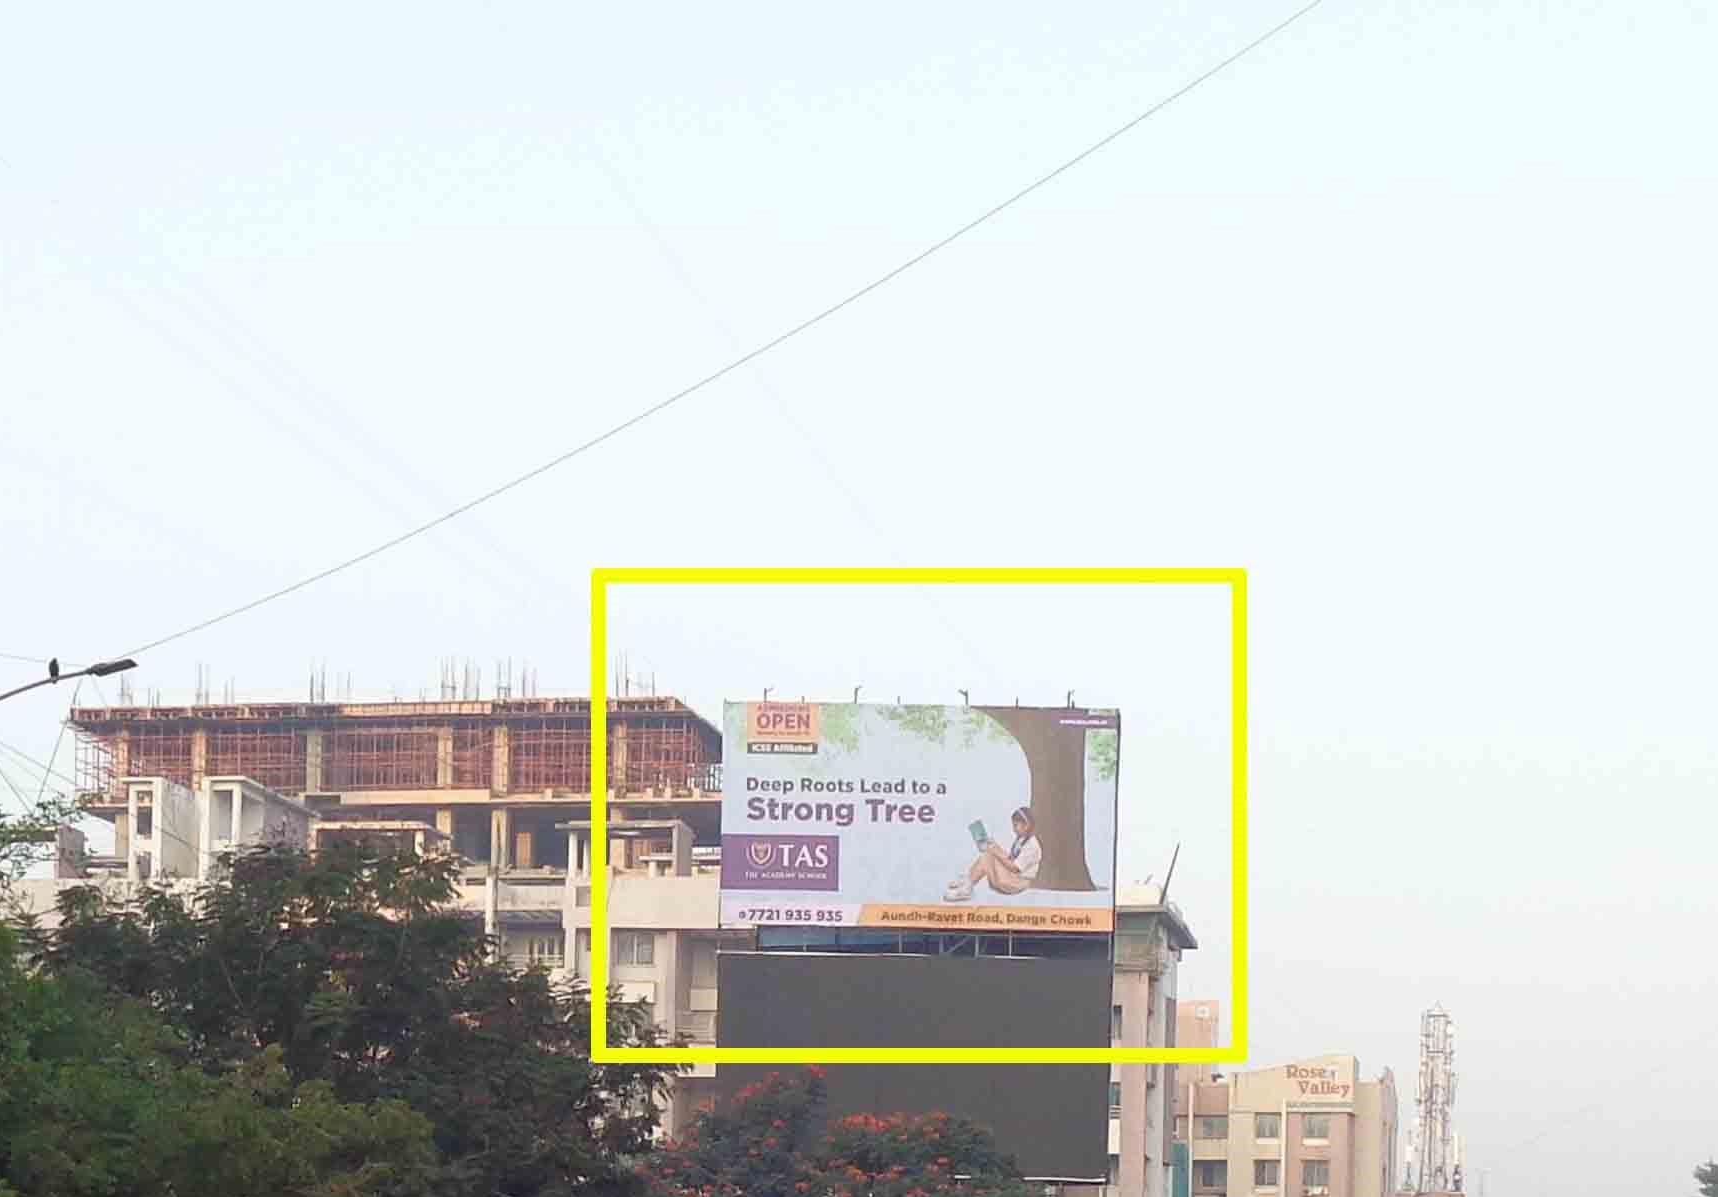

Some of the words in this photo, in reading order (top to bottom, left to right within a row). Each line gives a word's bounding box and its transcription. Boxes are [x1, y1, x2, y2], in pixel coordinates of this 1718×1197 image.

[756, 713, 810, 729] OPEN
[747, 777, 794, 794] Deep
[800, 778, 854, 793] Roots
[860, 779, 905, 793] Lead
[911, 780, 930, 794] to
[936, 784, 947, 794] a
[747, 797, 854, 826] Strong
[865, 799, 935, 823] Tree
[778, 844, 828, 868] TAS
[747, 909, 780, 921] 7721
[784, 909, 812, 921] 935
[816, 910, 843, 922] 935
[1050, 914, 1092, 926] Chowk
[1284, 1064, 1324, 1079] Rose
[1298, 1080, 1350, 1098] Valley
